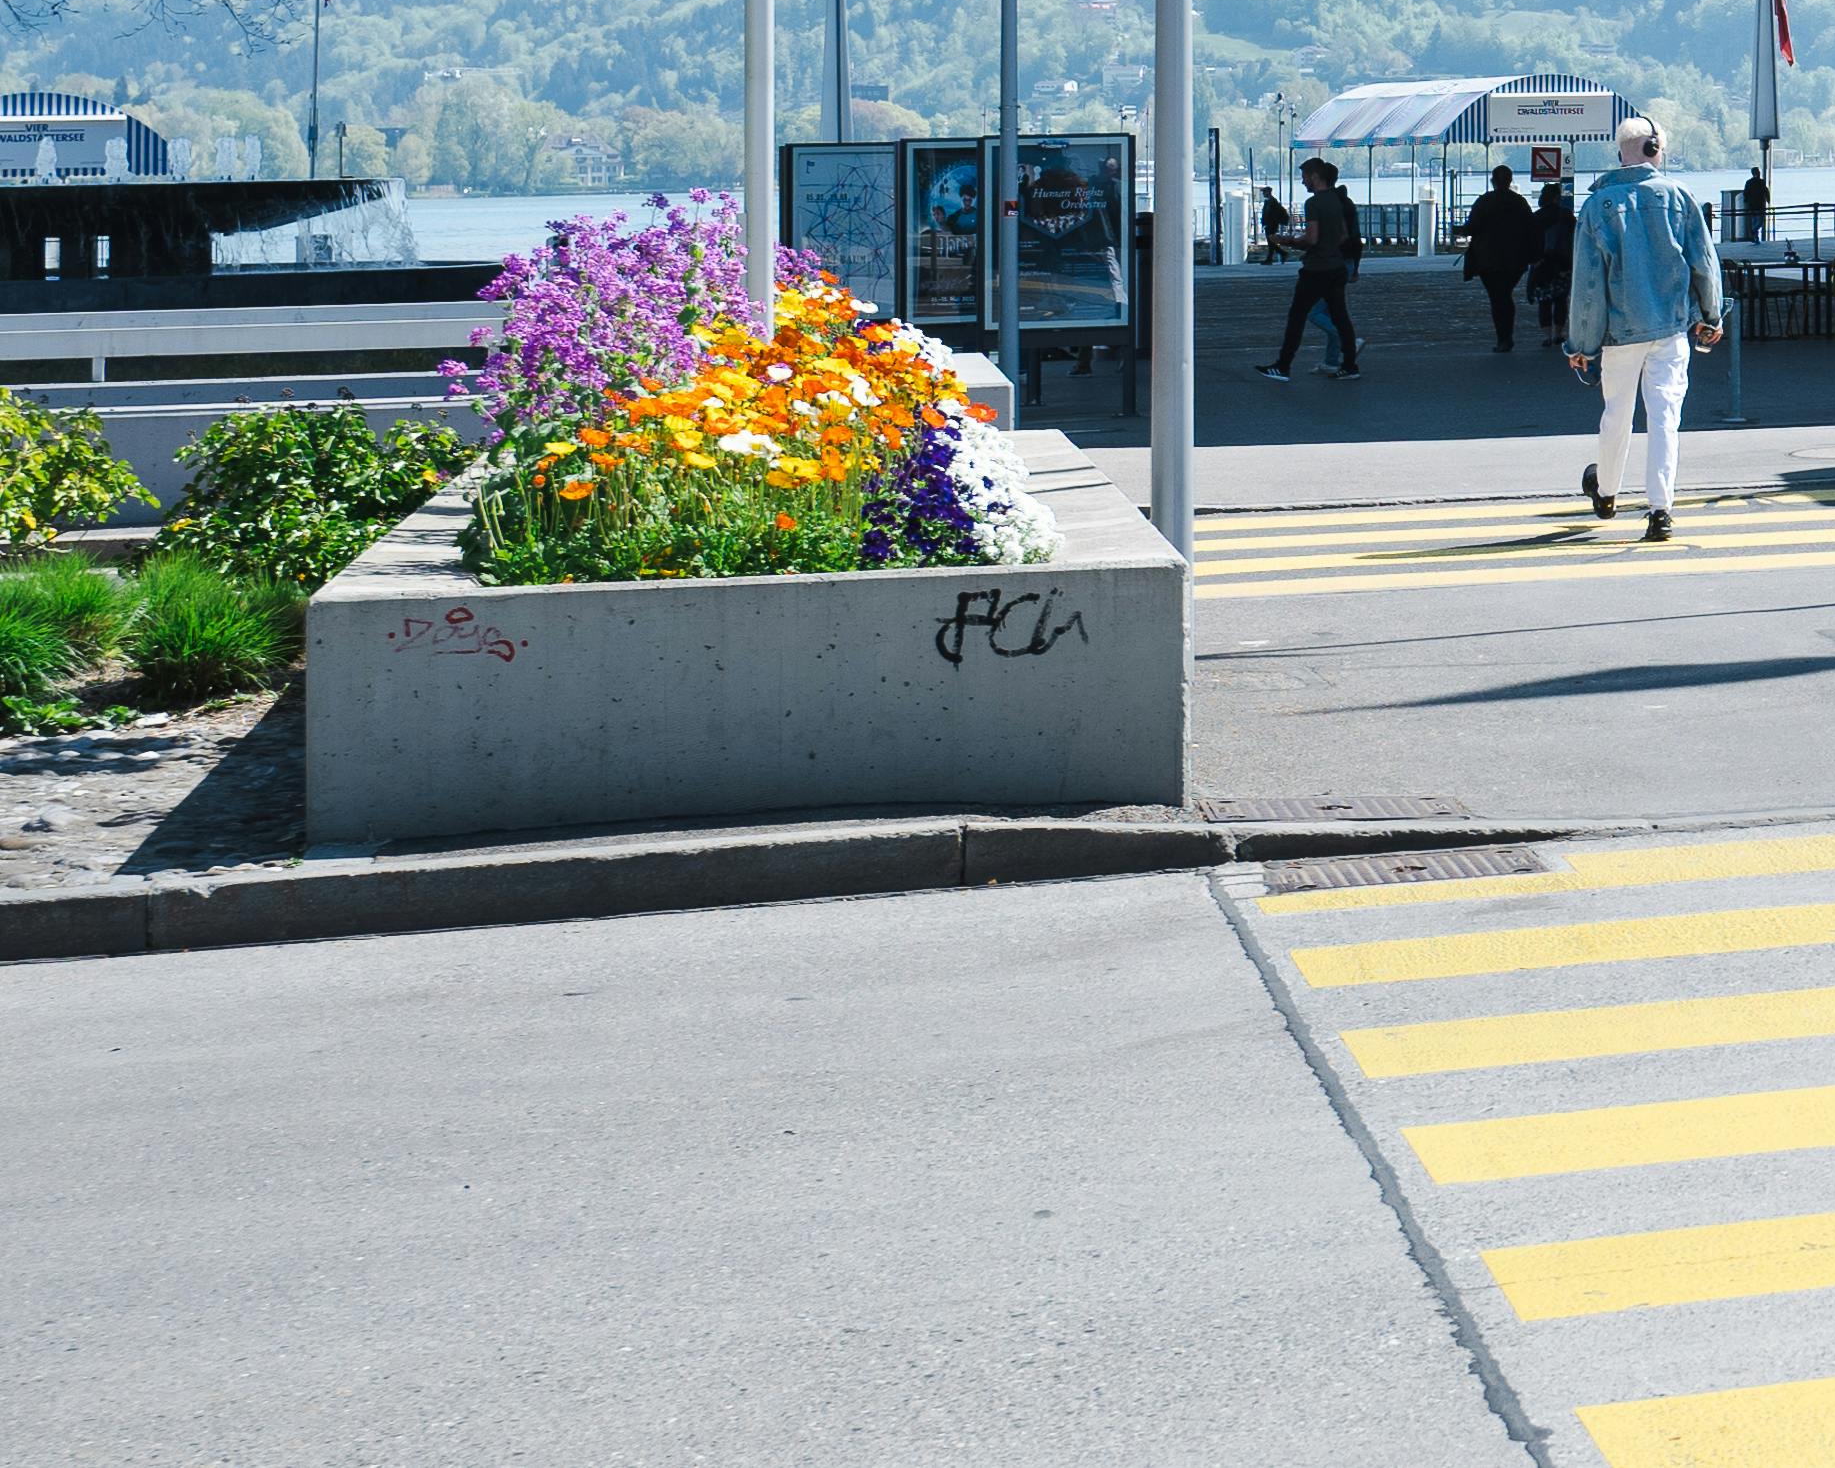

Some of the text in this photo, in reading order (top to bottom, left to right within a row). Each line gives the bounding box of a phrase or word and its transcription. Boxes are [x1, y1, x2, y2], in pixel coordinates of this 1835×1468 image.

[25, 123, 49, 132] VIER
[1564, 156, 1571, 165] 6
[1032, 186, 1105, 200] Human Rights
[1060, 199, 1108, 210] Orchestra
